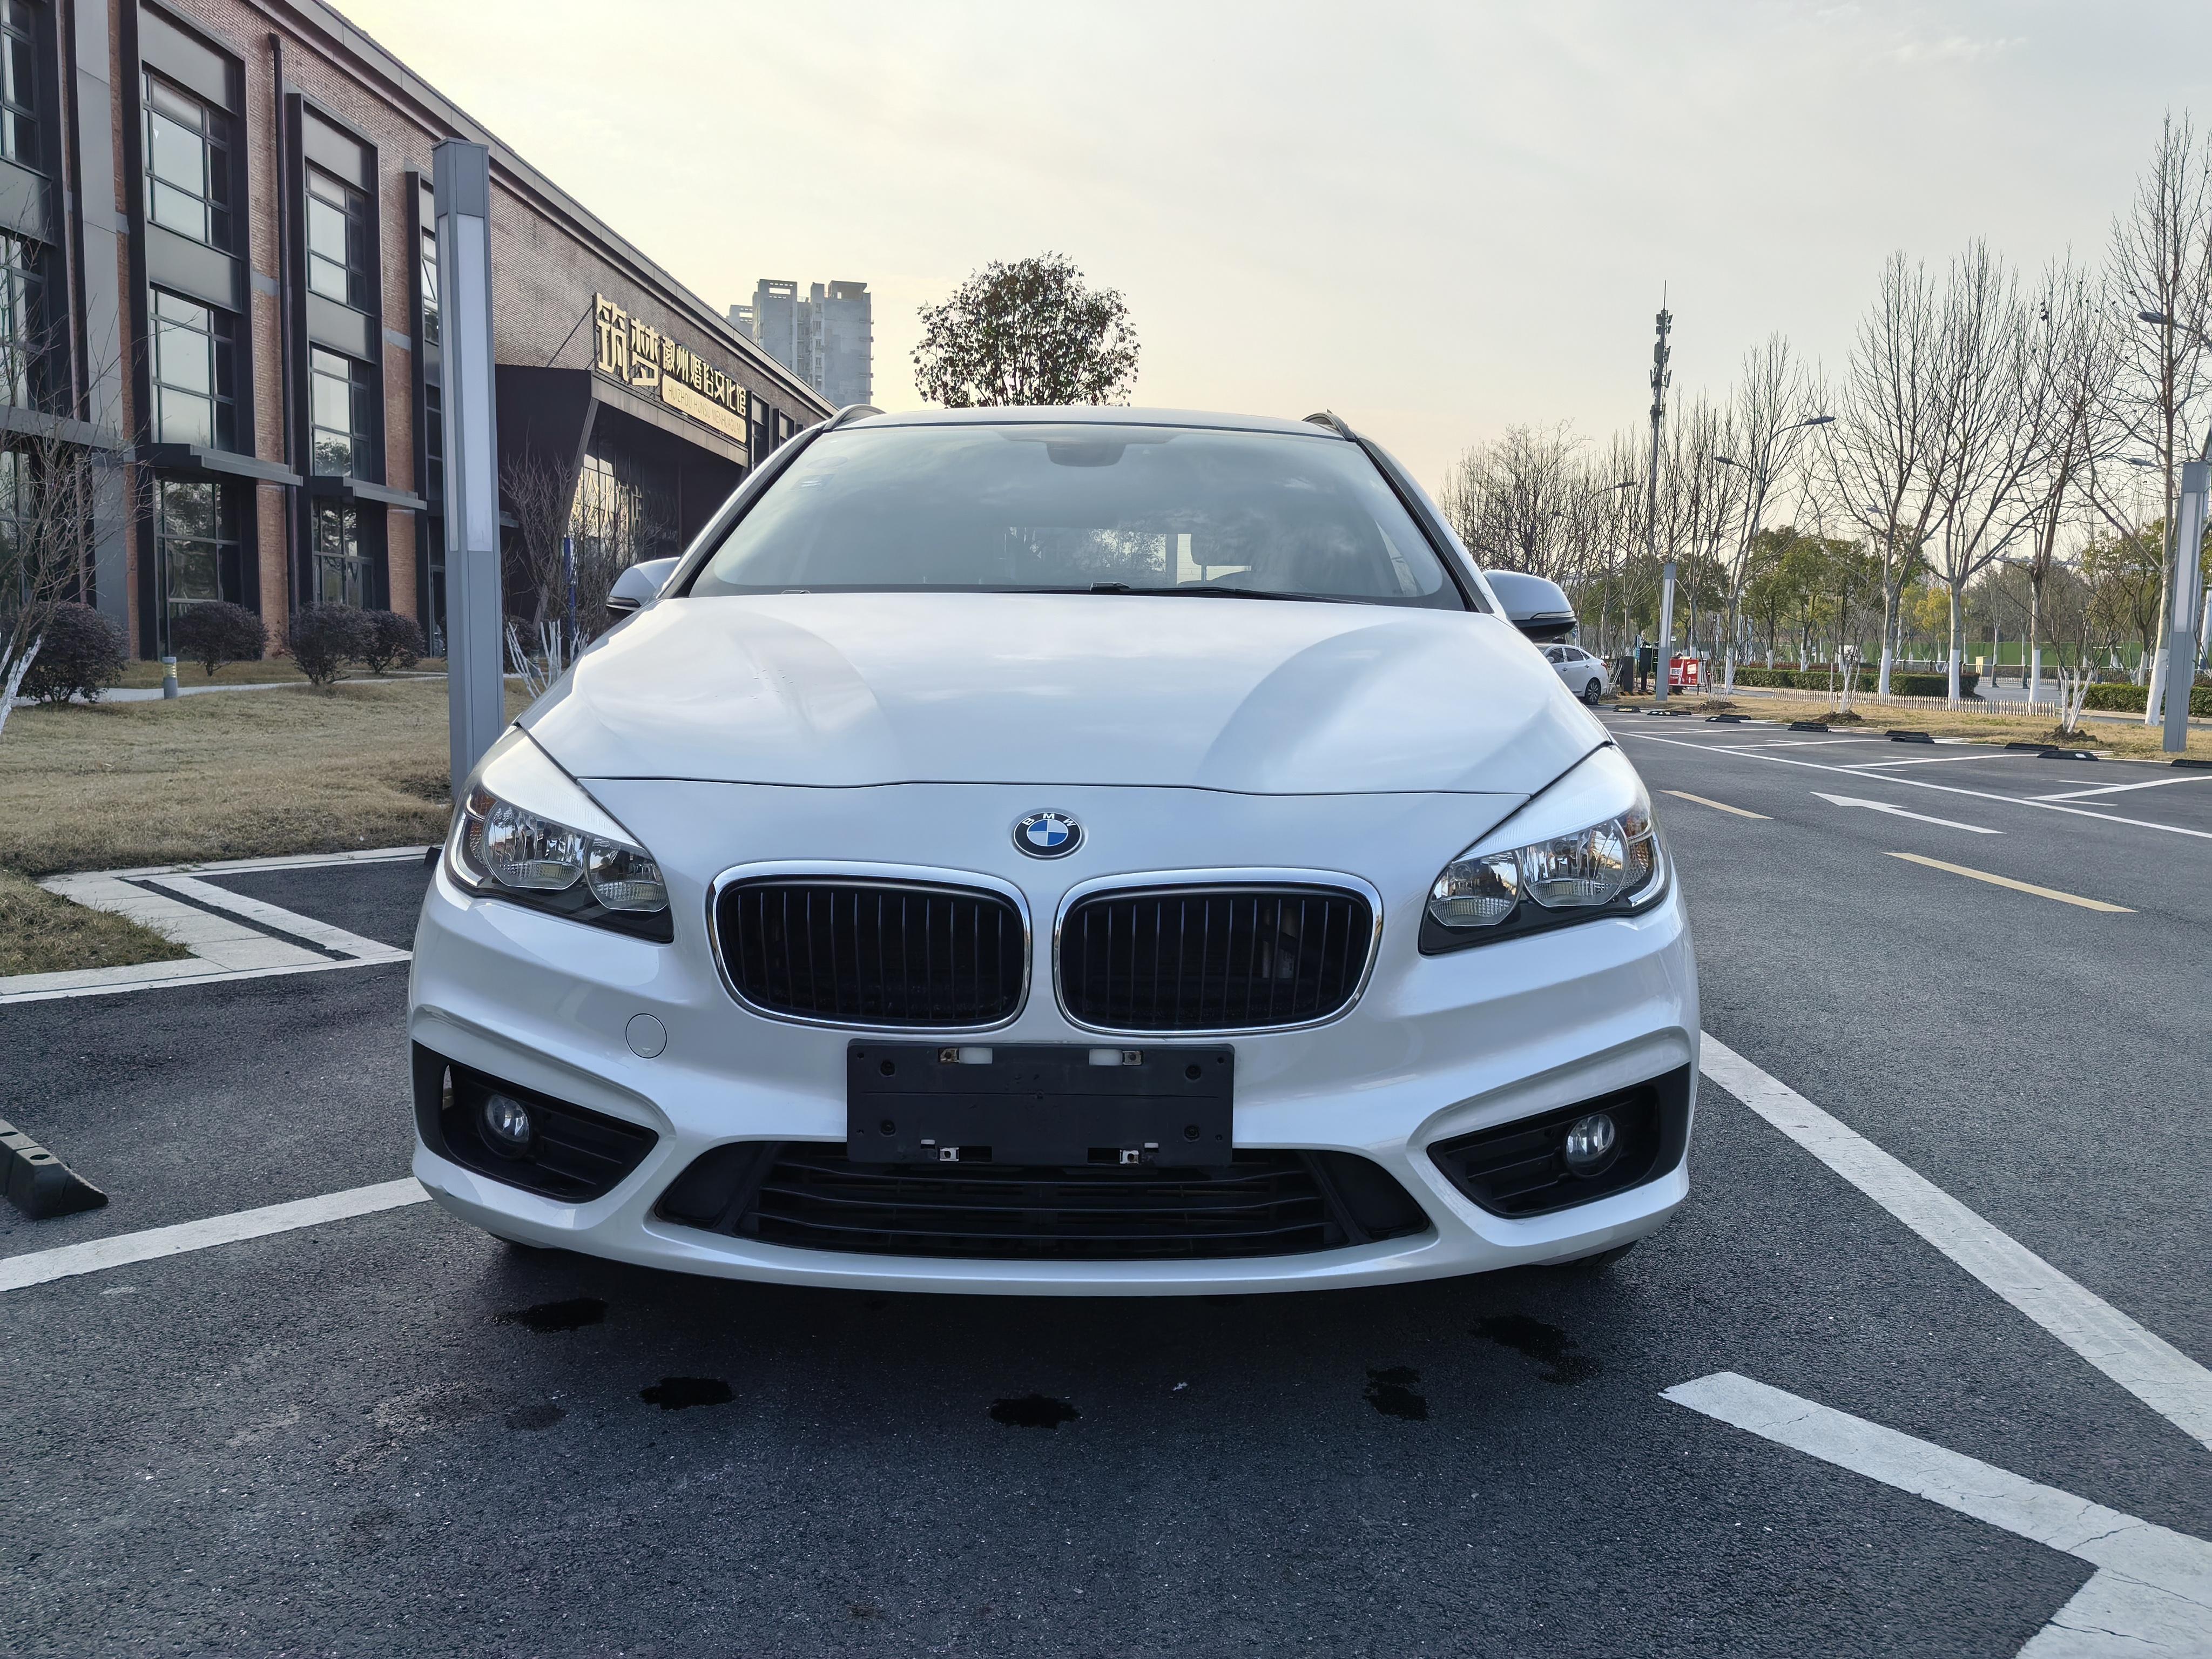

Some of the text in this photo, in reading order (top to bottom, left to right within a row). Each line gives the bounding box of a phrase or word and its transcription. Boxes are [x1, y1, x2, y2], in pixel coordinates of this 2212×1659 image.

[596, 292, 659, 386] 筑梦
[663, 335, 746, 416] 徽州婚俗文化馆
[668, 384, 692, 408] HUIZHOU
[694, 400, 710, 419] HUNSU
[1022, 813, 1076, 826] BMW
